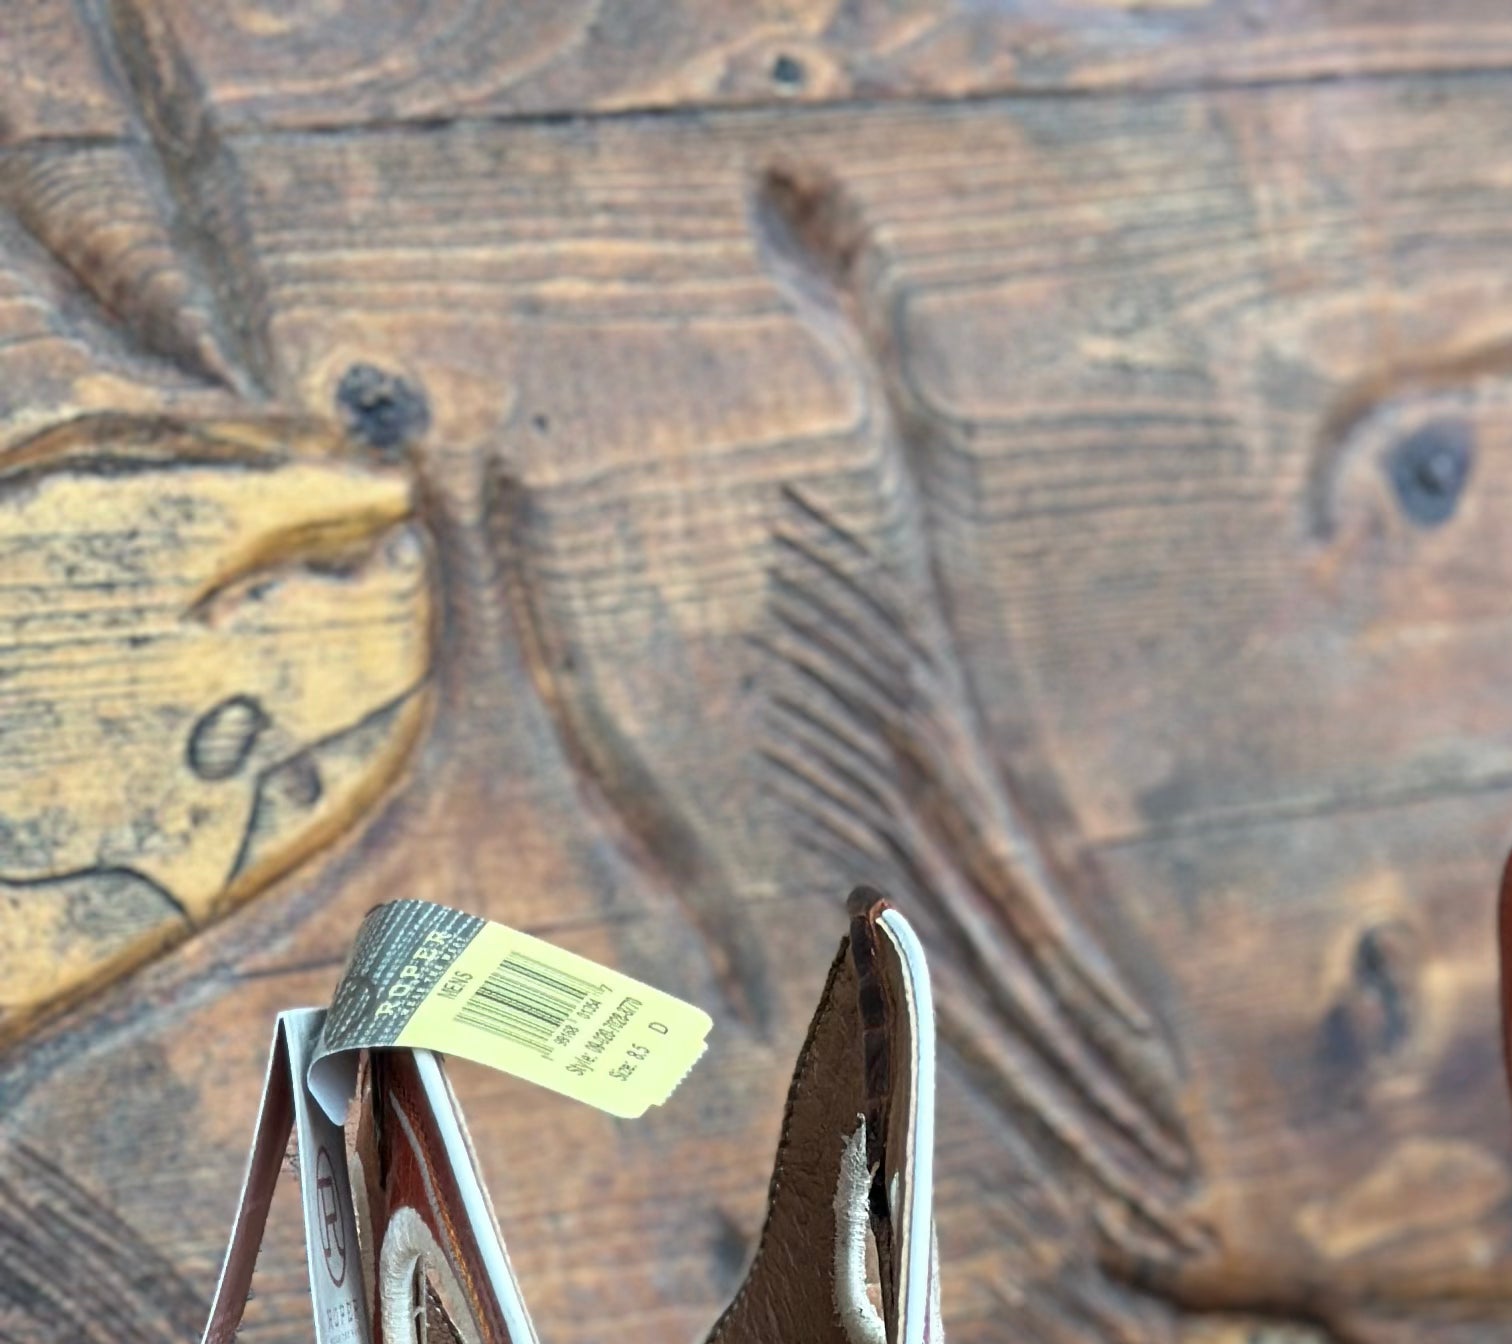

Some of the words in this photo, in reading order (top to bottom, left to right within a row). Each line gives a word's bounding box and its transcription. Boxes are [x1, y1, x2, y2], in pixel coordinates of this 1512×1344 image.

[375, 929, 452, 1018] ROPER
[437, 971, 473, 1000] MENS
[565, 1052, 597, 1076] Style:
[609, 1061, 637, 1081] Size:
[627, 1043, 650, 1060] 8.5
[648, 1022, 668, 1035] D
